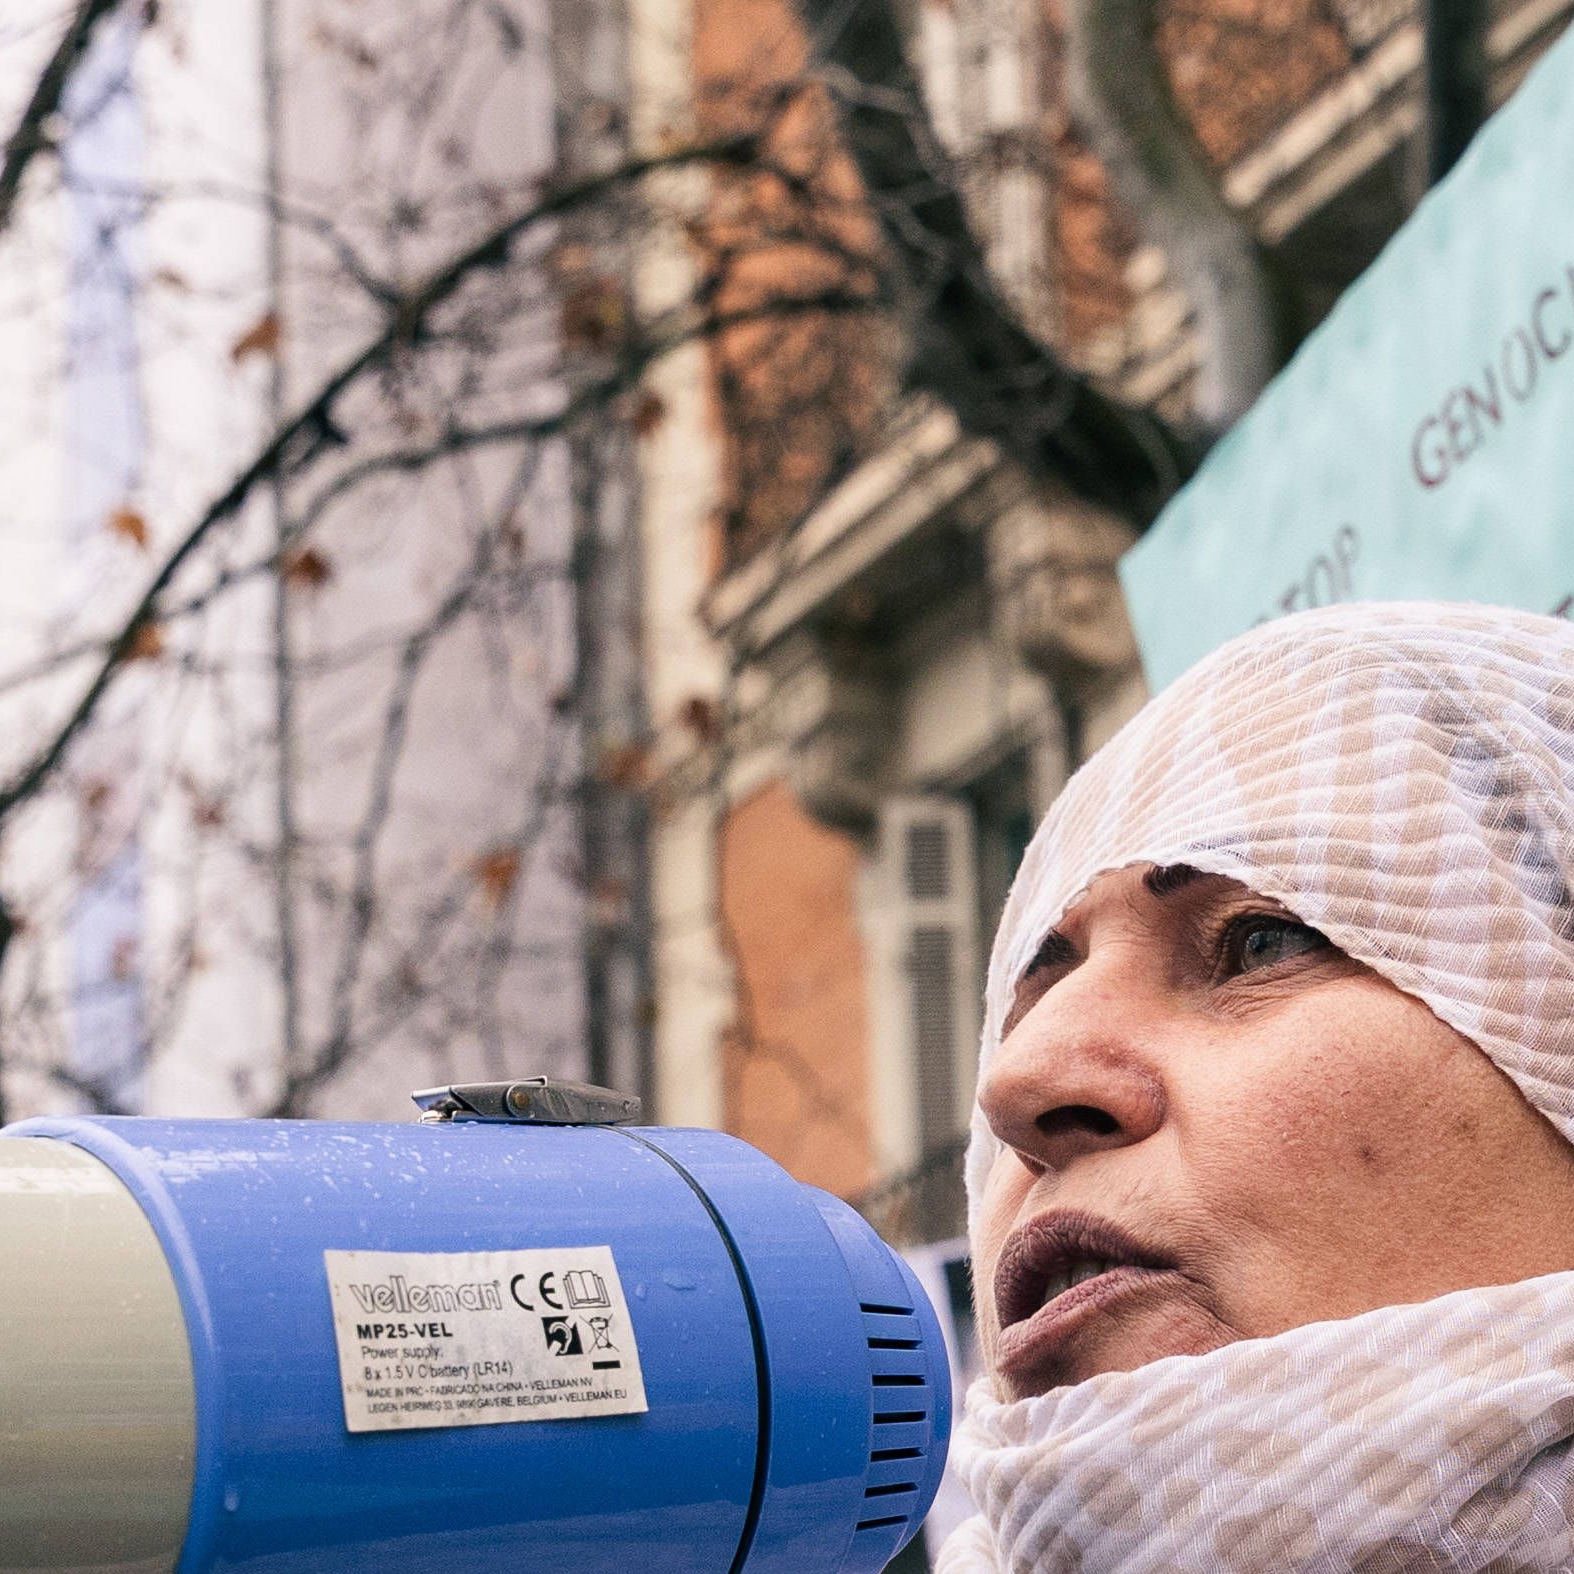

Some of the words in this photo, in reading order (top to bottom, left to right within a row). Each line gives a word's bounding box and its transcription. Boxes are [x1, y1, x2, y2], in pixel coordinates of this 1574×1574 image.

[1248, 522, 1362, 628] OP
[356, 1322, 453, 1340] MP25-VEL
[361, 1345, 398, 1359] Power
[429, 1364, 470, 1380] battery
[473, 1360, 514, 1379] (LR14)
[366, 1387, 392, 1398] MADE
[430, 1383, 480, 1395] FABRICADO
[495, 1381, 524, 1393] CHINA
[529, 1378, 578, 1391] VELLEMAN
[516, 1394, 557, 1407] BELGIUM
